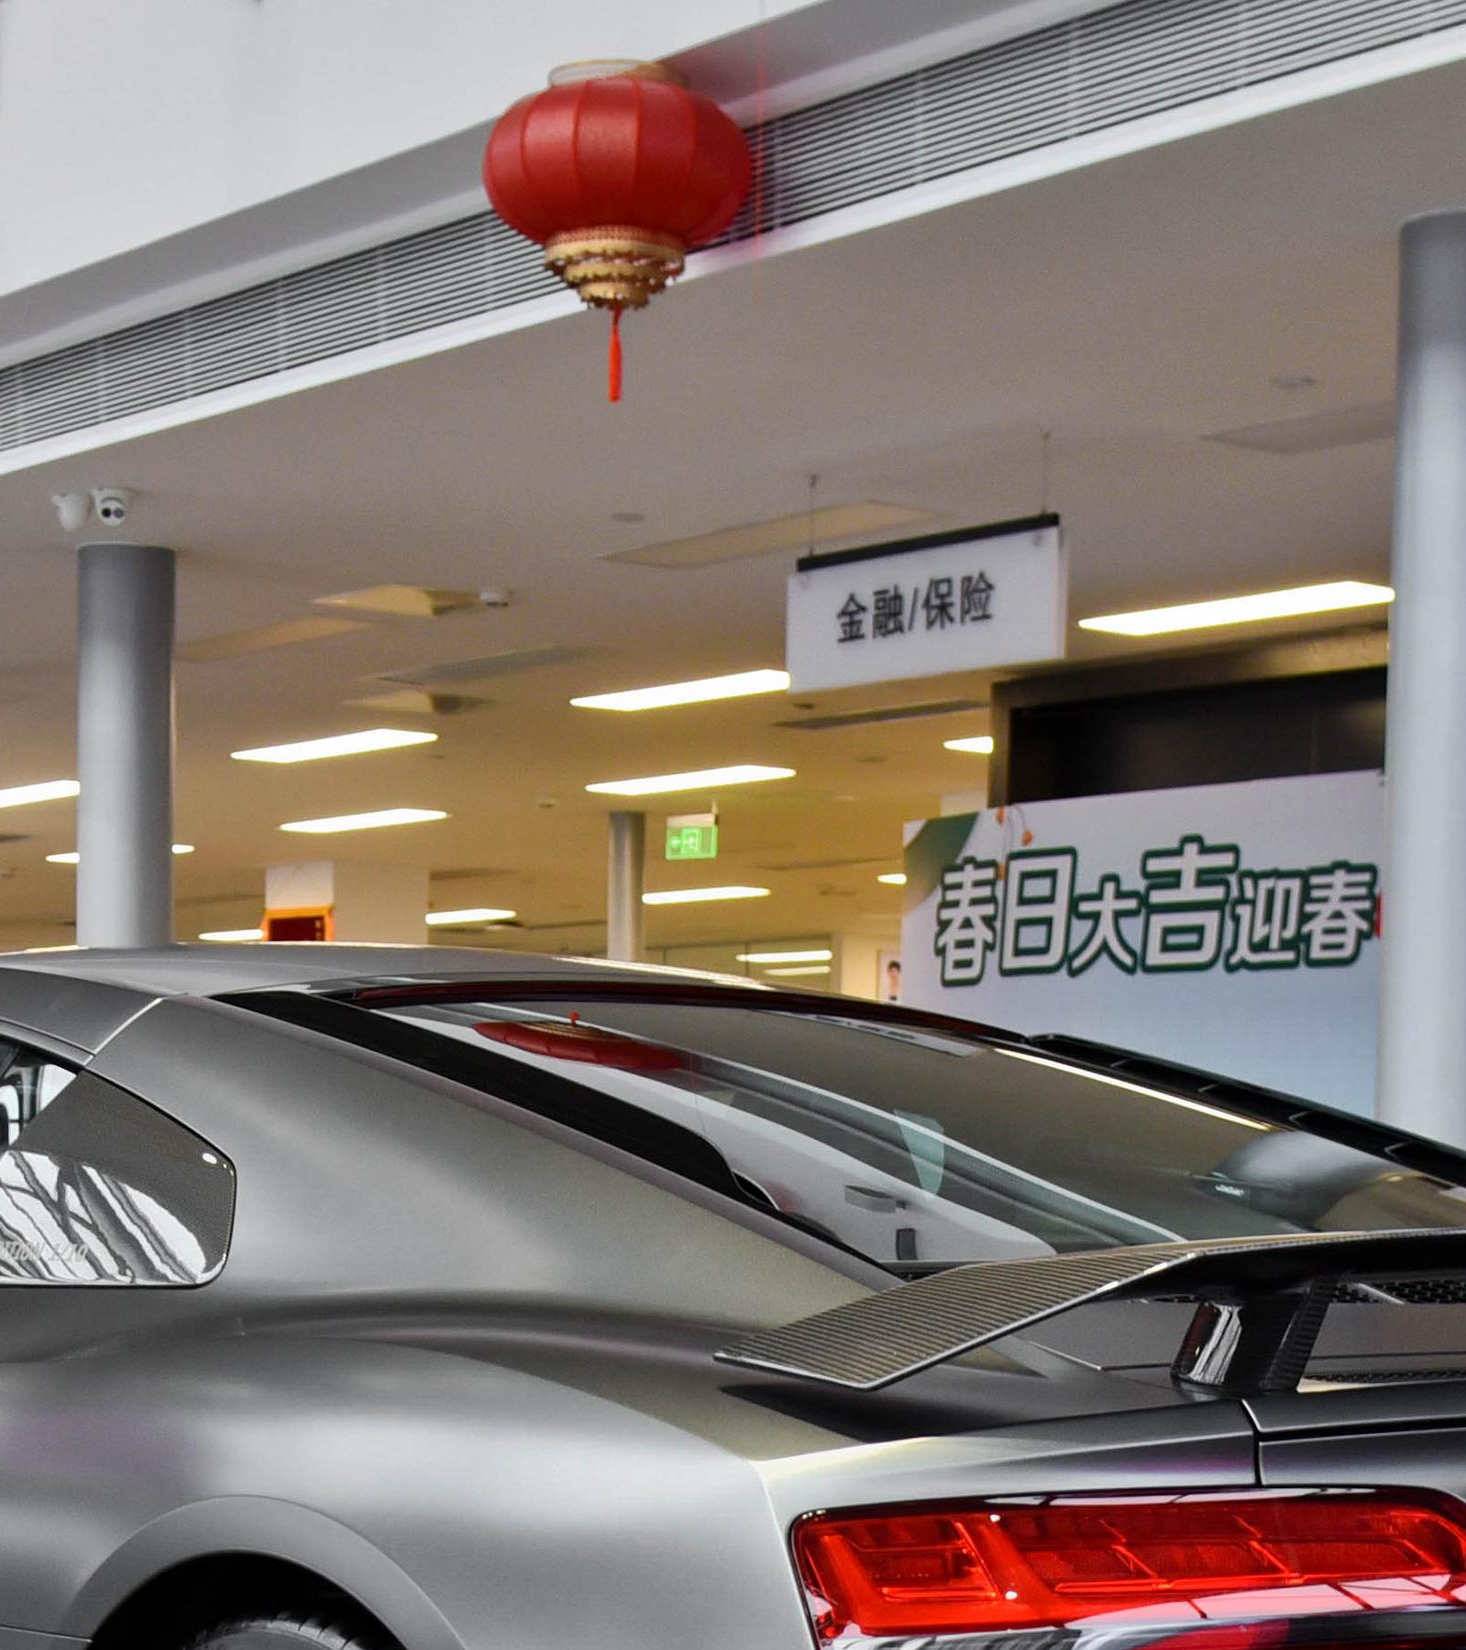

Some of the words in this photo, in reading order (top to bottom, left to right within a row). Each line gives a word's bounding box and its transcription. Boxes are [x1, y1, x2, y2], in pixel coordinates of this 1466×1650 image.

[836, 571, 995, 644] 金融/保险
[934, 834, 1378, 986] 春日大吉迎春
